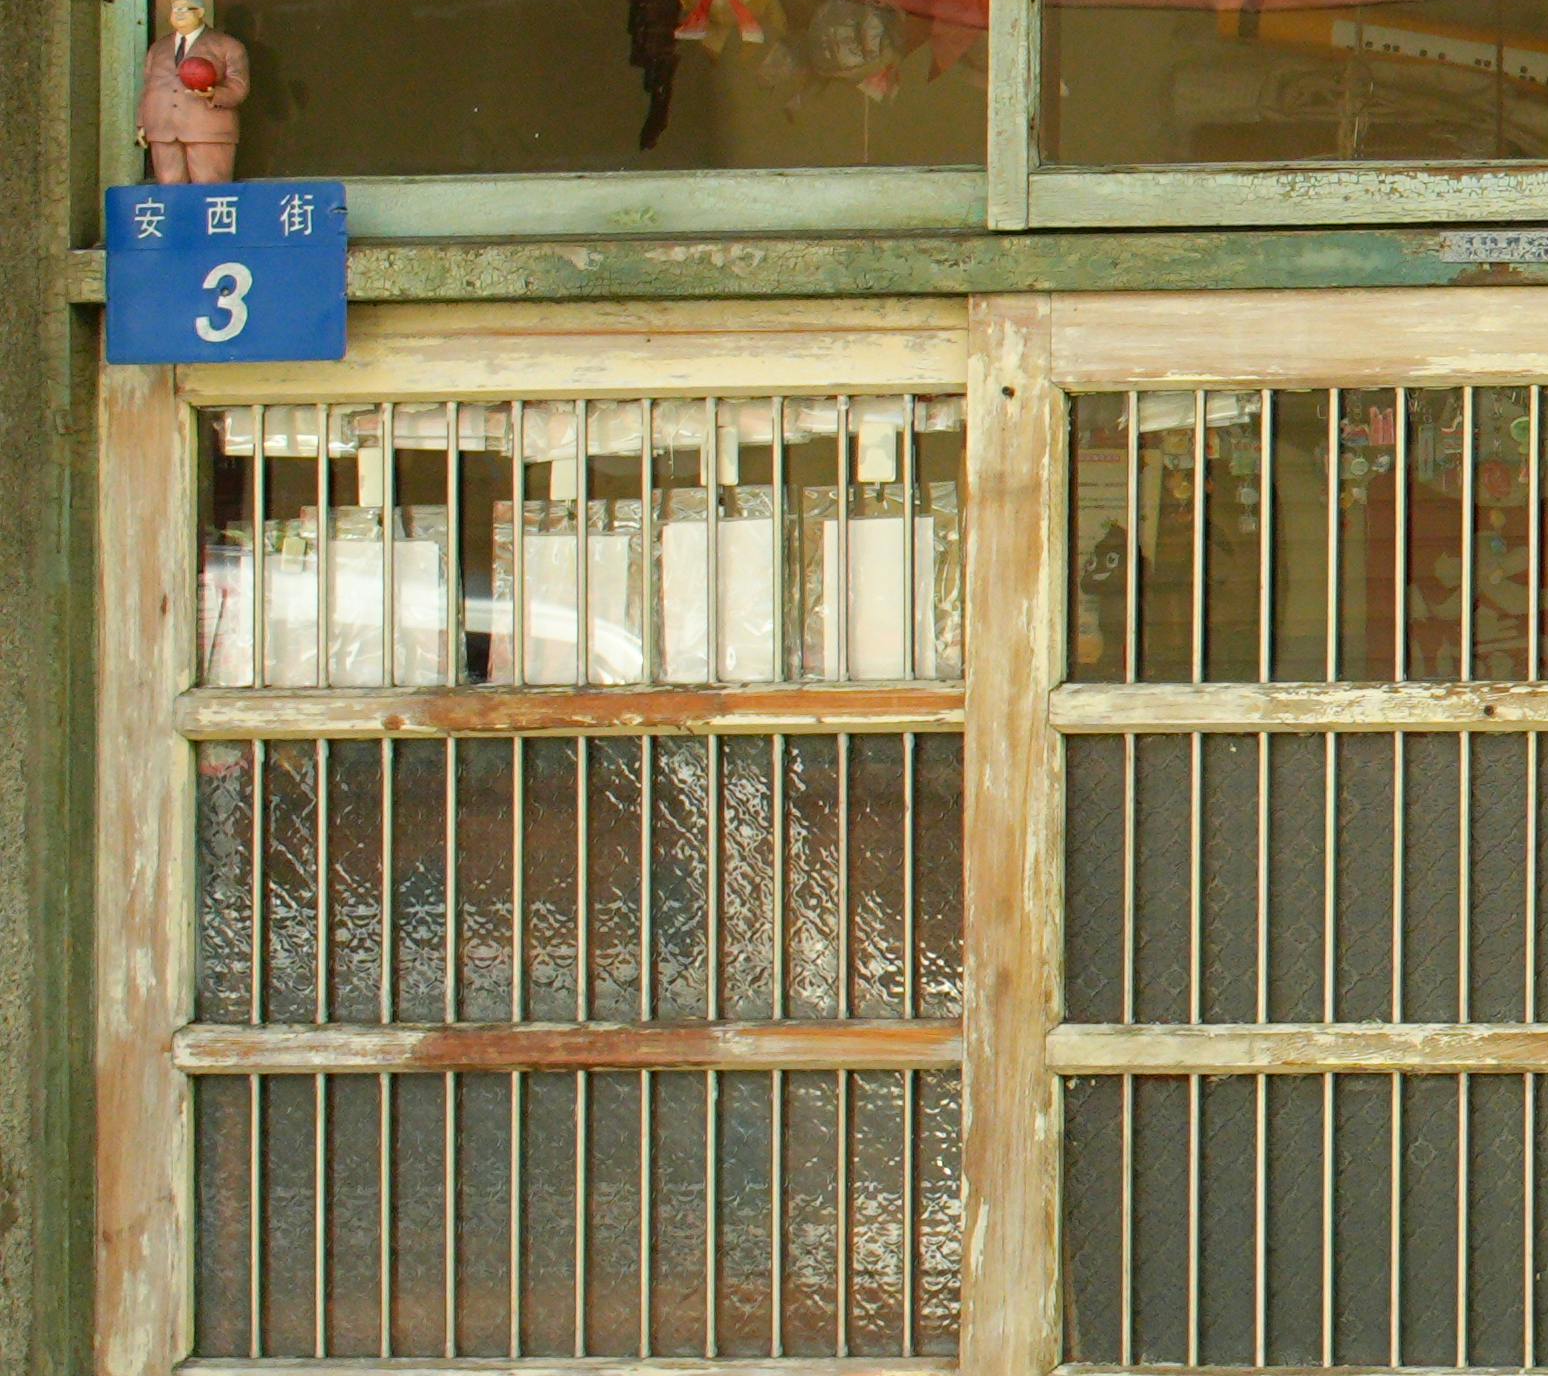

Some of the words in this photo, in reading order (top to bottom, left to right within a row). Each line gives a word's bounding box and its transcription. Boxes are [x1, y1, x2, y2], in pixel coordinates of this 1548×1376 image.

[134, 194, 315, 240] 安西街
[195, 262, 253, 343] 3
